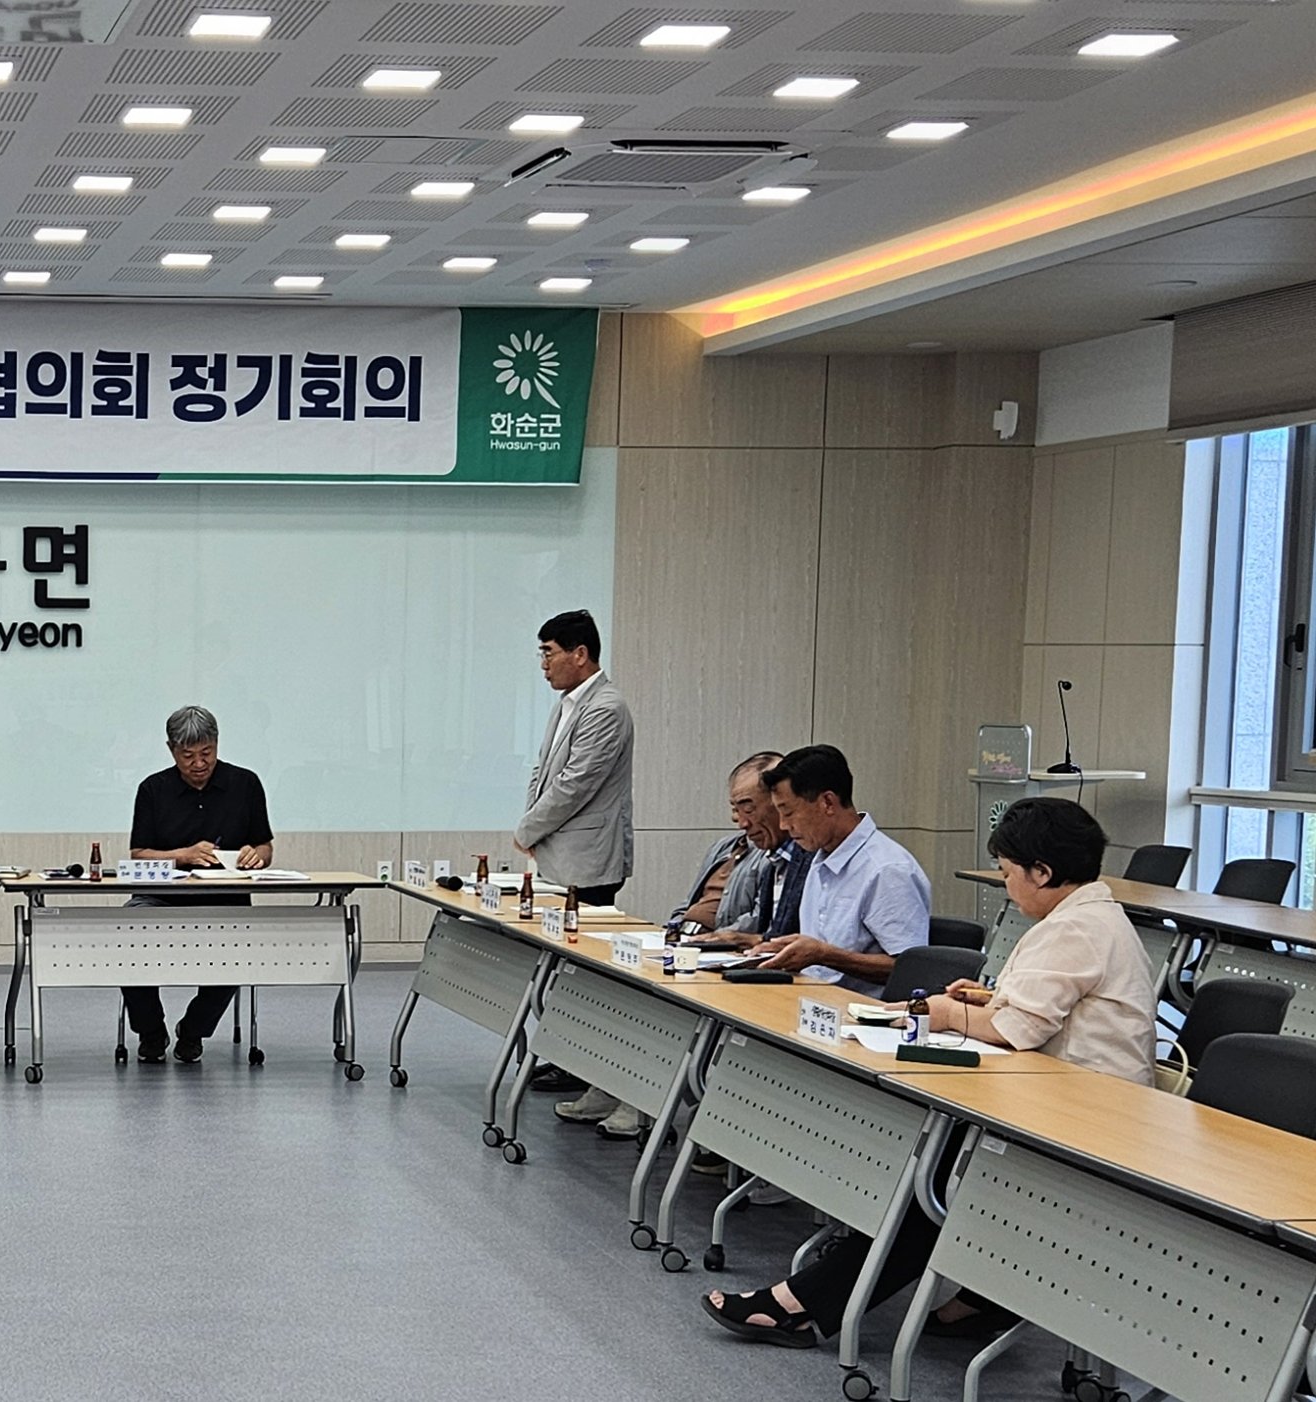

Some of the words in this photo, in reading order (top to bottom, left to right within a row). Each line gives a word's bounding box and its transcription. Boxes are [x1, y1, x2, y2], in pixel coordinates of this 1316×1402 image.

[169, 351, 423, 423] 정기회의
[489, 412, 562, 438] 화순군
[490, 439, 561, 452] Hwasun-gun
